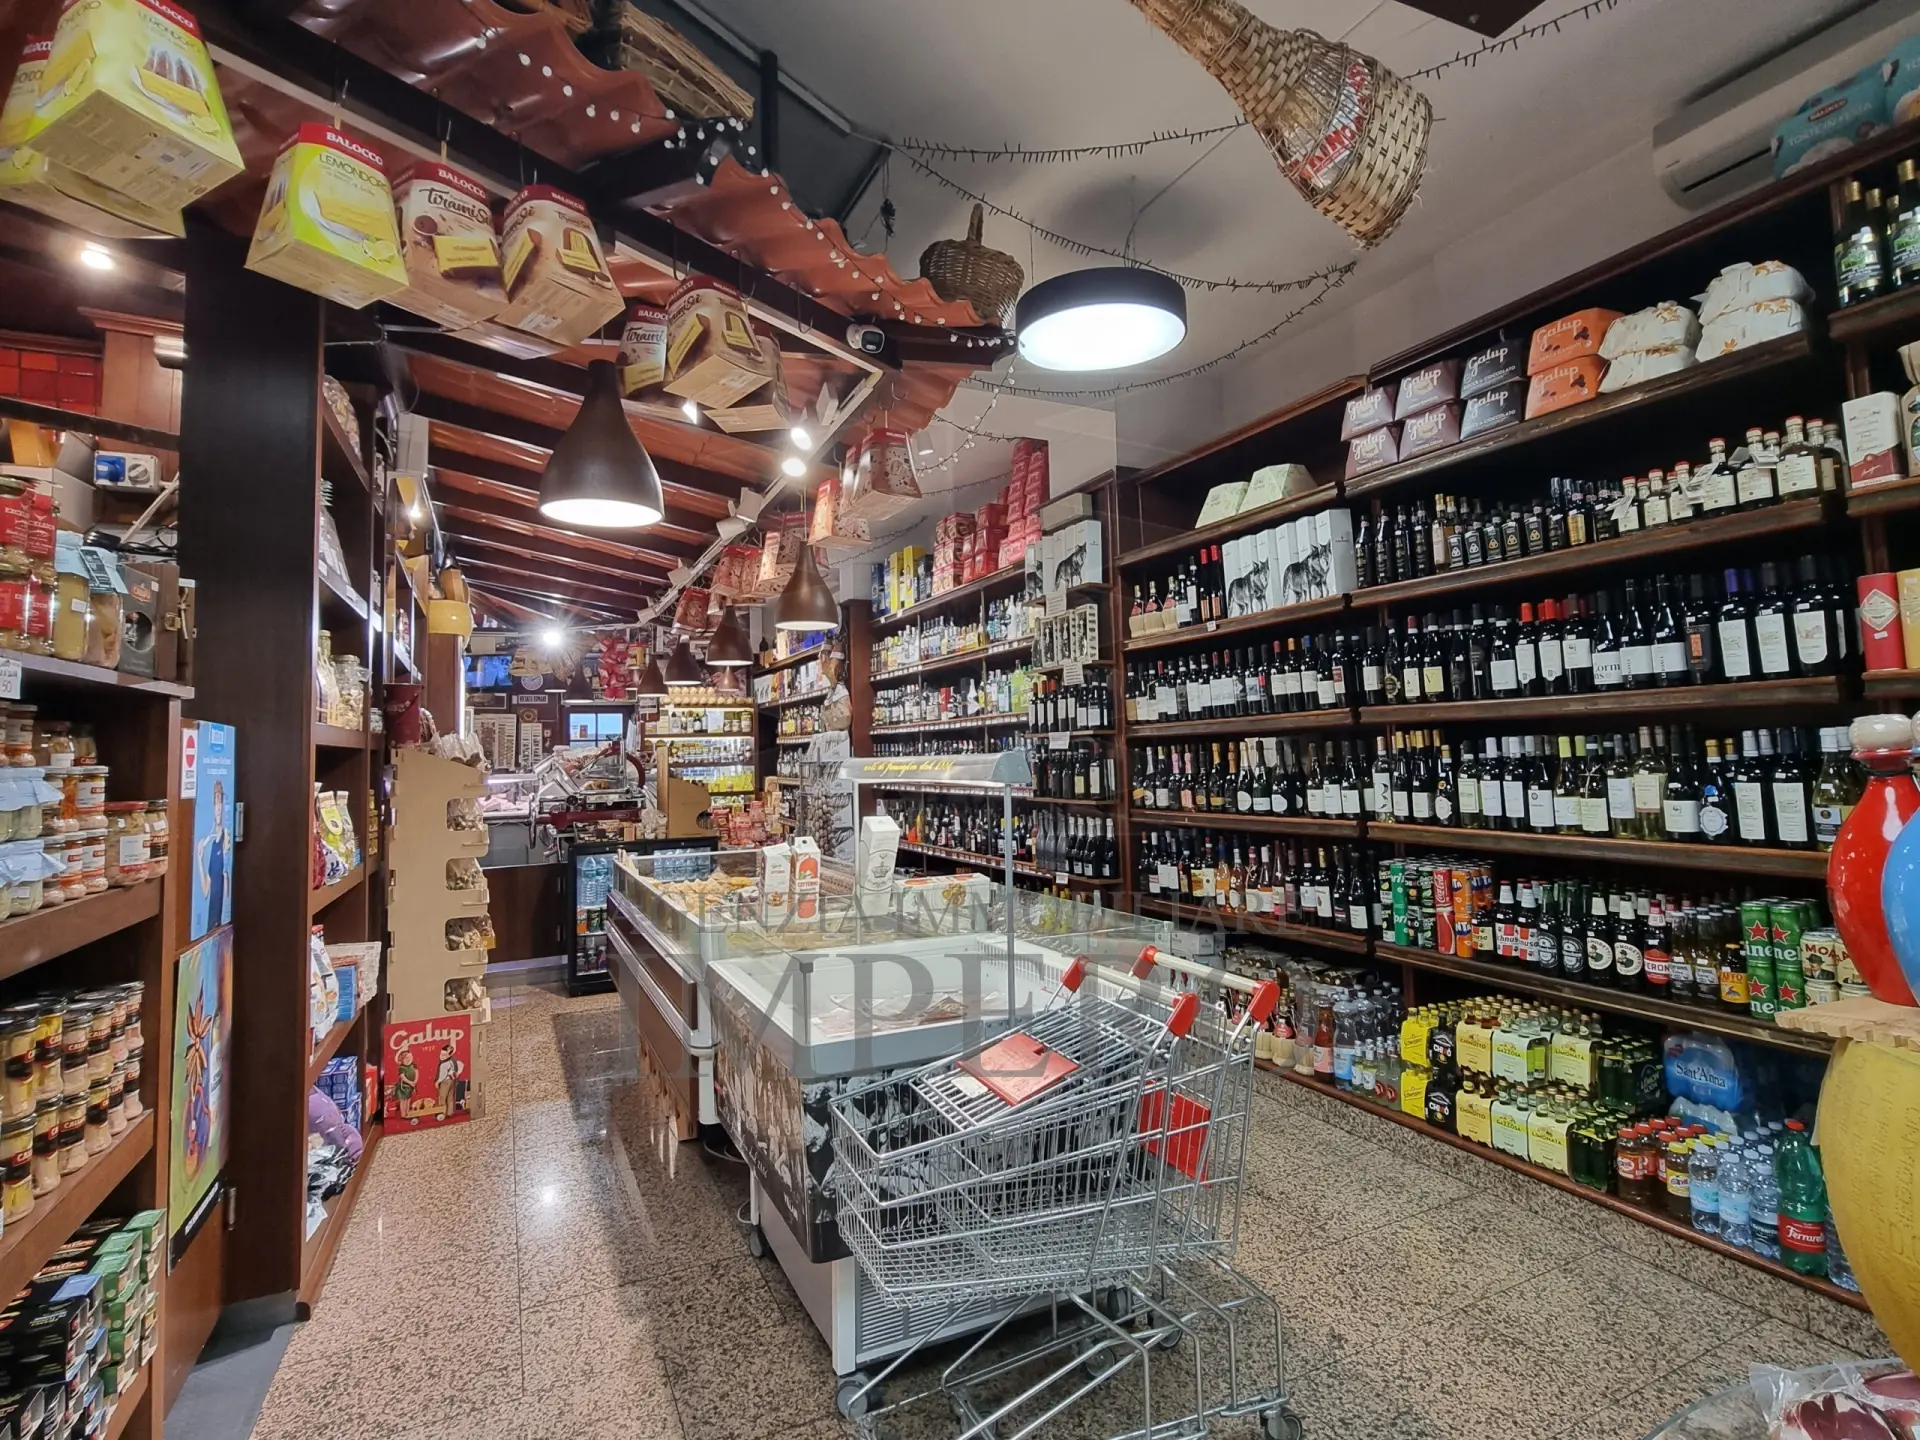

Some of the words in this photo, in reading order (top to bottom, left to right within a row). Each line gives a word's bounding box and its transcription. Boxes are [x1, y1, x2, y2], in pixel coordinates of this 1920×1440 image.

[326, 131, 384, 167] BALOCCO
[438, 167, 487, 199] BALOCCO
[1537, 318, 1582, 351] Galup
[1468, 347, 1509, 377] Galup
[1483, 364, 1516, 382] CIOCCOLATO
[1403, 368, 1442, 399] Galup
[1534, 366, 1579, 397] Galup
[1347, 394, 1382, 421] Galup
[1468, 390, 1509, 419] Galup
[1407, 412, 1447, 441] Galup
[1352, 433, 1387, 460] Galup
[389, 1021, 464, 1064] Galup
[1460, 1037, 1487, 1049] CHINOTTO
[1497, 1046, 1522, 1058] GAZZOSA
[1555, 1048, 1585, 1061] LIMONATA
[1675, 1060, 1728, 1089] Sant'Anna
[1460, 1106, 1486, 1119] CHINOTTO
[1496, 1118, 1522, 1133] GAZZOSA
[1532, 1131, 1562, 1146] LIMONATA
